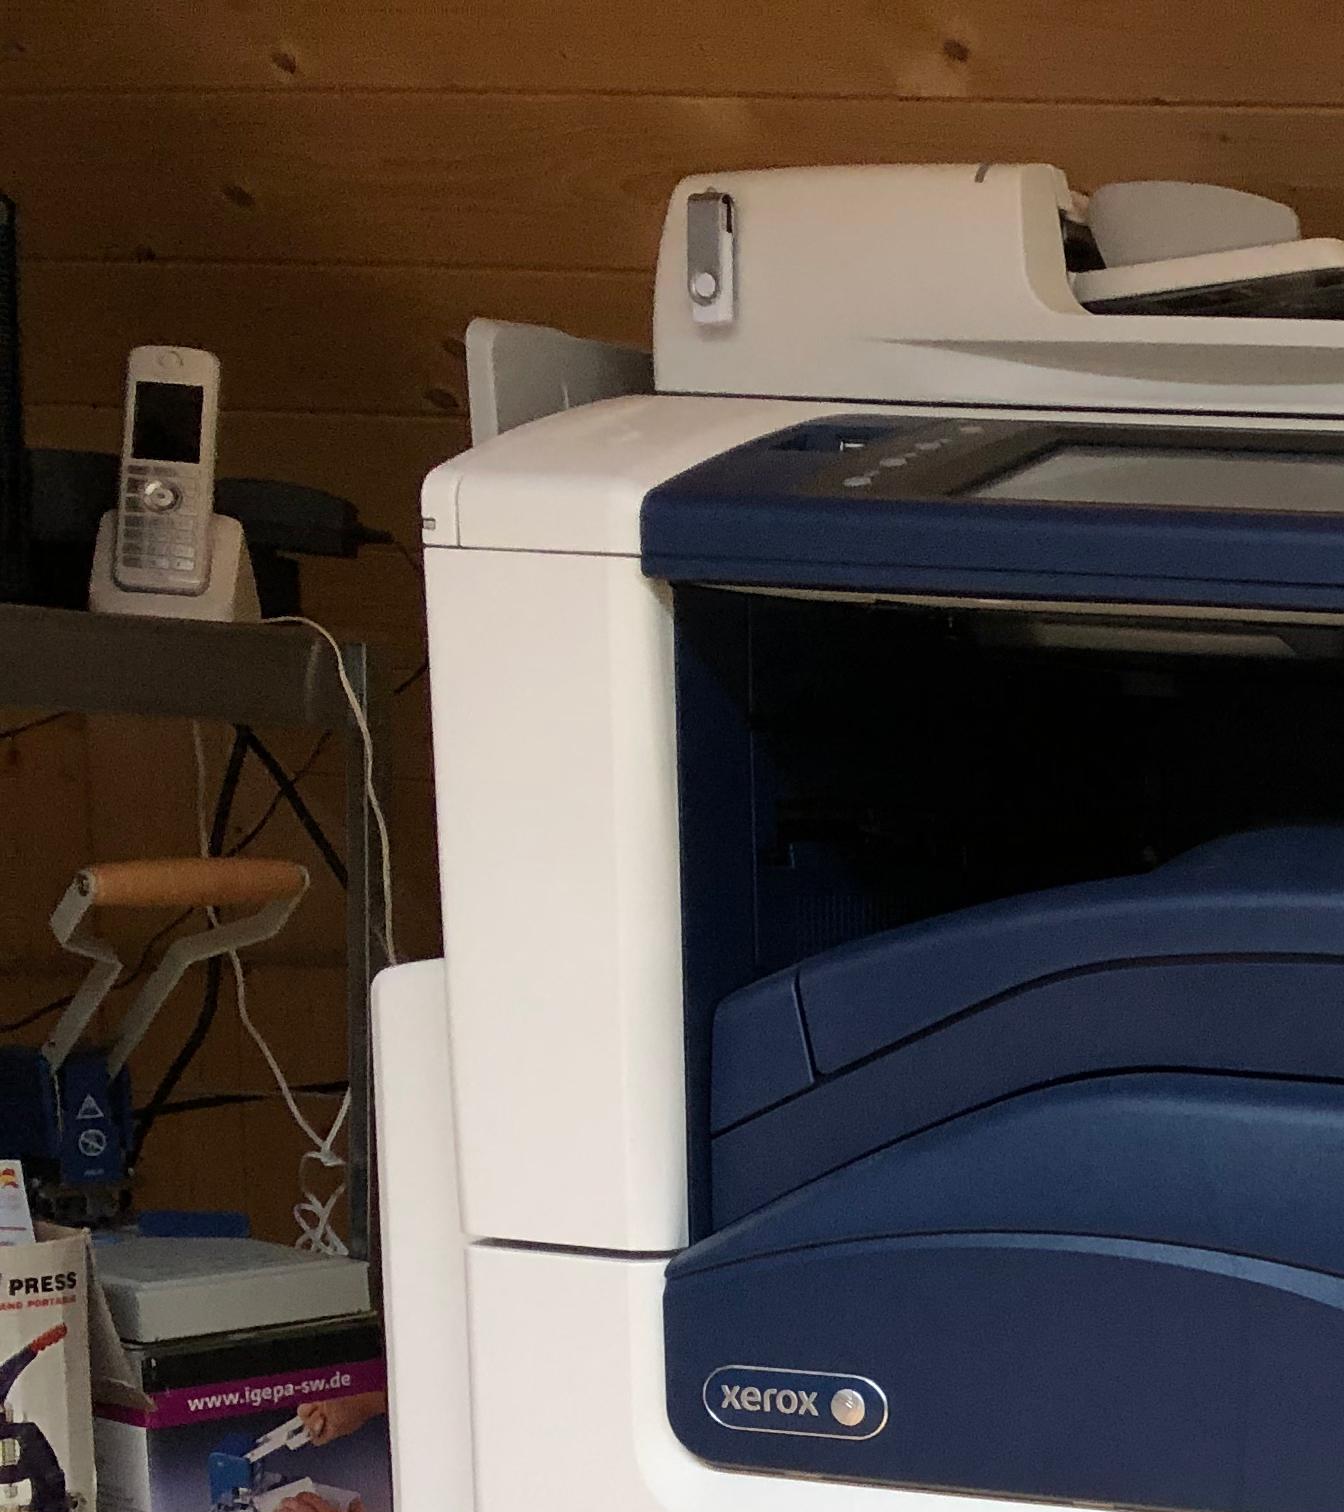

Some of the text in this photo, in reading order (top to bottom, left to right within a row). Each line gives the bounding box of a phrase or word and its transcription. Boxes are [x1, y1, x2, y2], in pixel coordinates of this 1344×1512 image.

[9, 1271, 77, 1296] PRESS
[187, 1371, 351, 1412] www.igepa-sw.de
[720, 1384, 819, 1416] xerox
